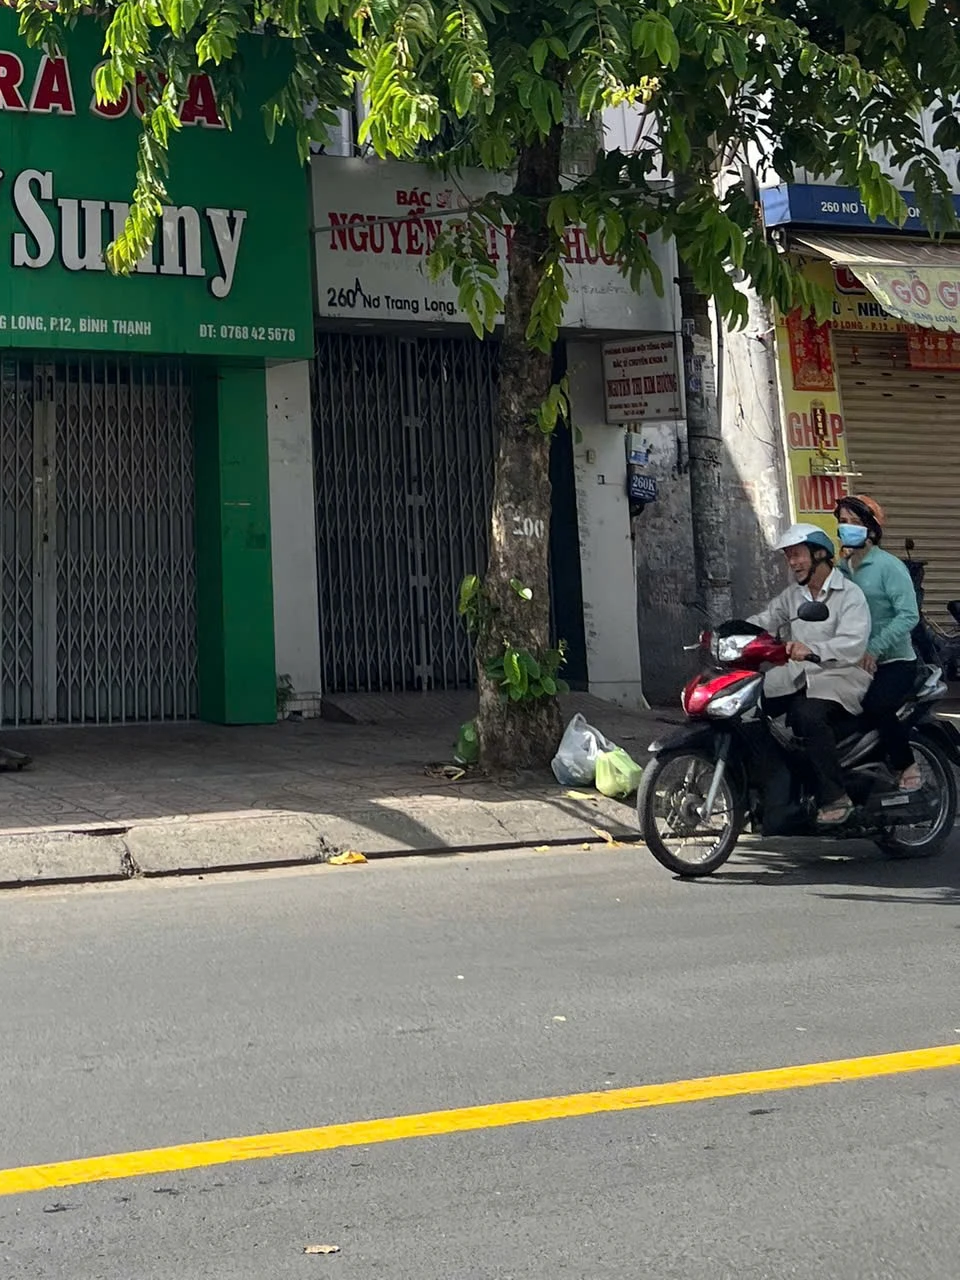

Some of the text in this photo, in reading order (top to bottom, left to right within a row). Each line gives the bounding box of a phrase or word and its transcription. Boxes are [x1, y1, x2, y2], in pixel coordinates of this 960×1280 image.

[396, 187, 431, 207] BÁC
[821, 201, 839, 213] 260
[385, 295, 419, 314] Trang
[425, 297, 457, 315] Long,
[11, 315, 47, 332] LONG,
[79, 315, 108, 333] BÌNH
[112, 319, 152, 337] THẠNH
[199, 324, 295, 341] ĐT: 0768 42 5678
[788, 411, 844, 449] GHP
